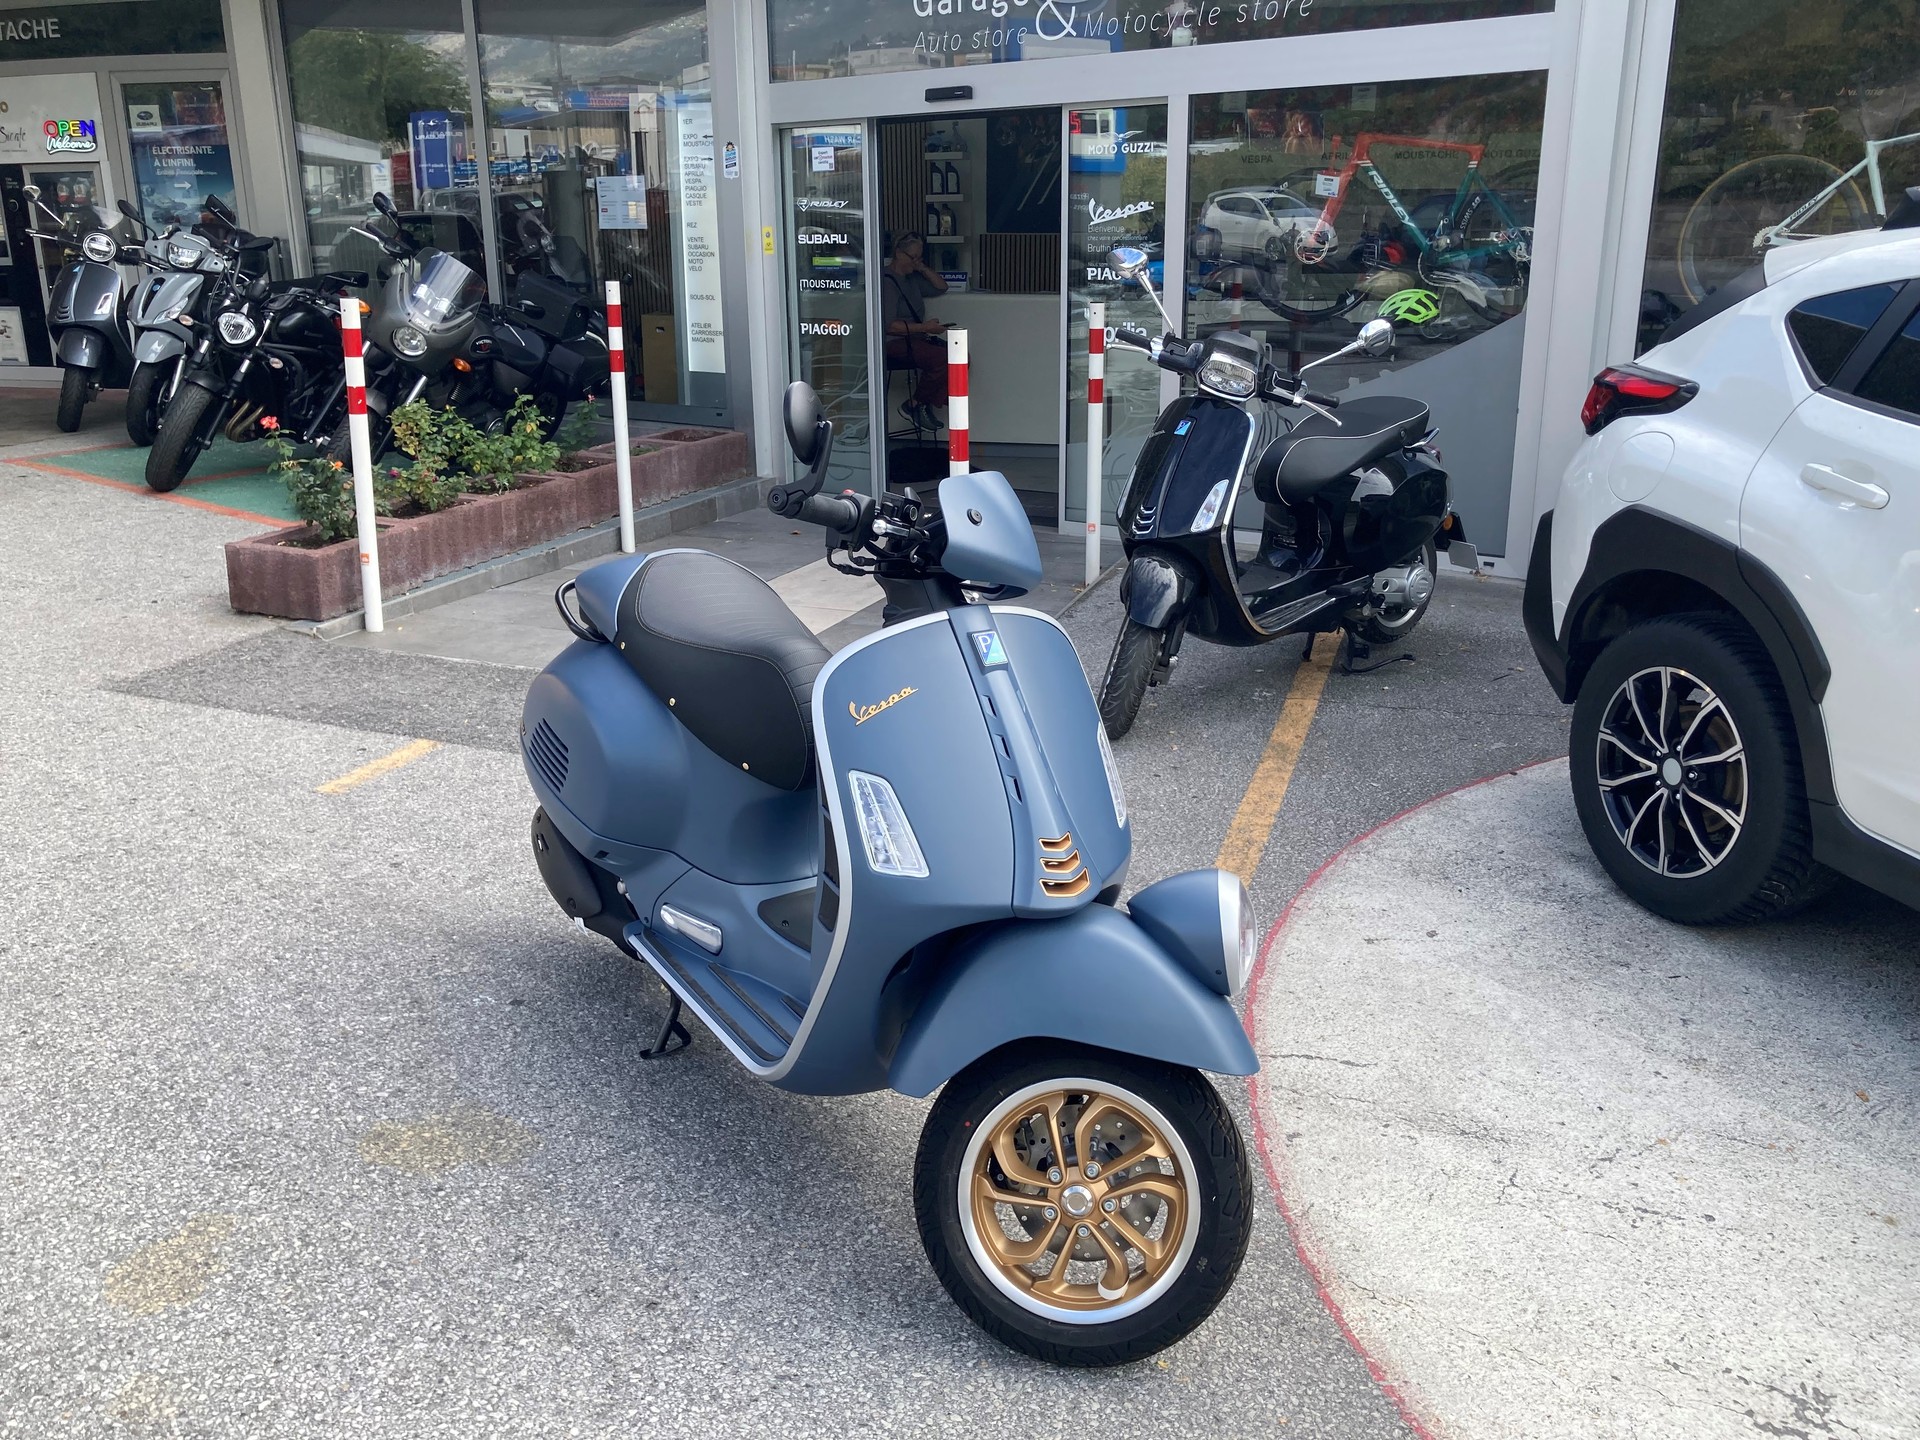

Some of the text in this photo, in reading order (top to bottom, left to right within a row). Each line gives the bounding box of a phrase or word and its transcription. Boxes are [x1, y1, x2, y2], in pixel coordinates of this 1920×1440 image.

[1083, 0, 1222, 37] Motocycle
[912, 26, 1028, 54] Auto store
[43, 120, 96, 137] OPEN
[47, 135, 98, 153] Welcome
[1088, 142, 1154, 155] MOTO GUZZI
[1241, 154, 1274, 163] VESPA
[1368, 170, 1416, 227] RIDLEY
[1088, 197, 1153, 226] Vespa
[1087, 225, 1125, 233] Bienvenue
[798, 234, 848, 244] SUBARU
[800, 279, 851, 291] MOUSTACHE
[800, 323, 850, 336] PIAGGIO
[848, 686, 919, 726] Vespa
